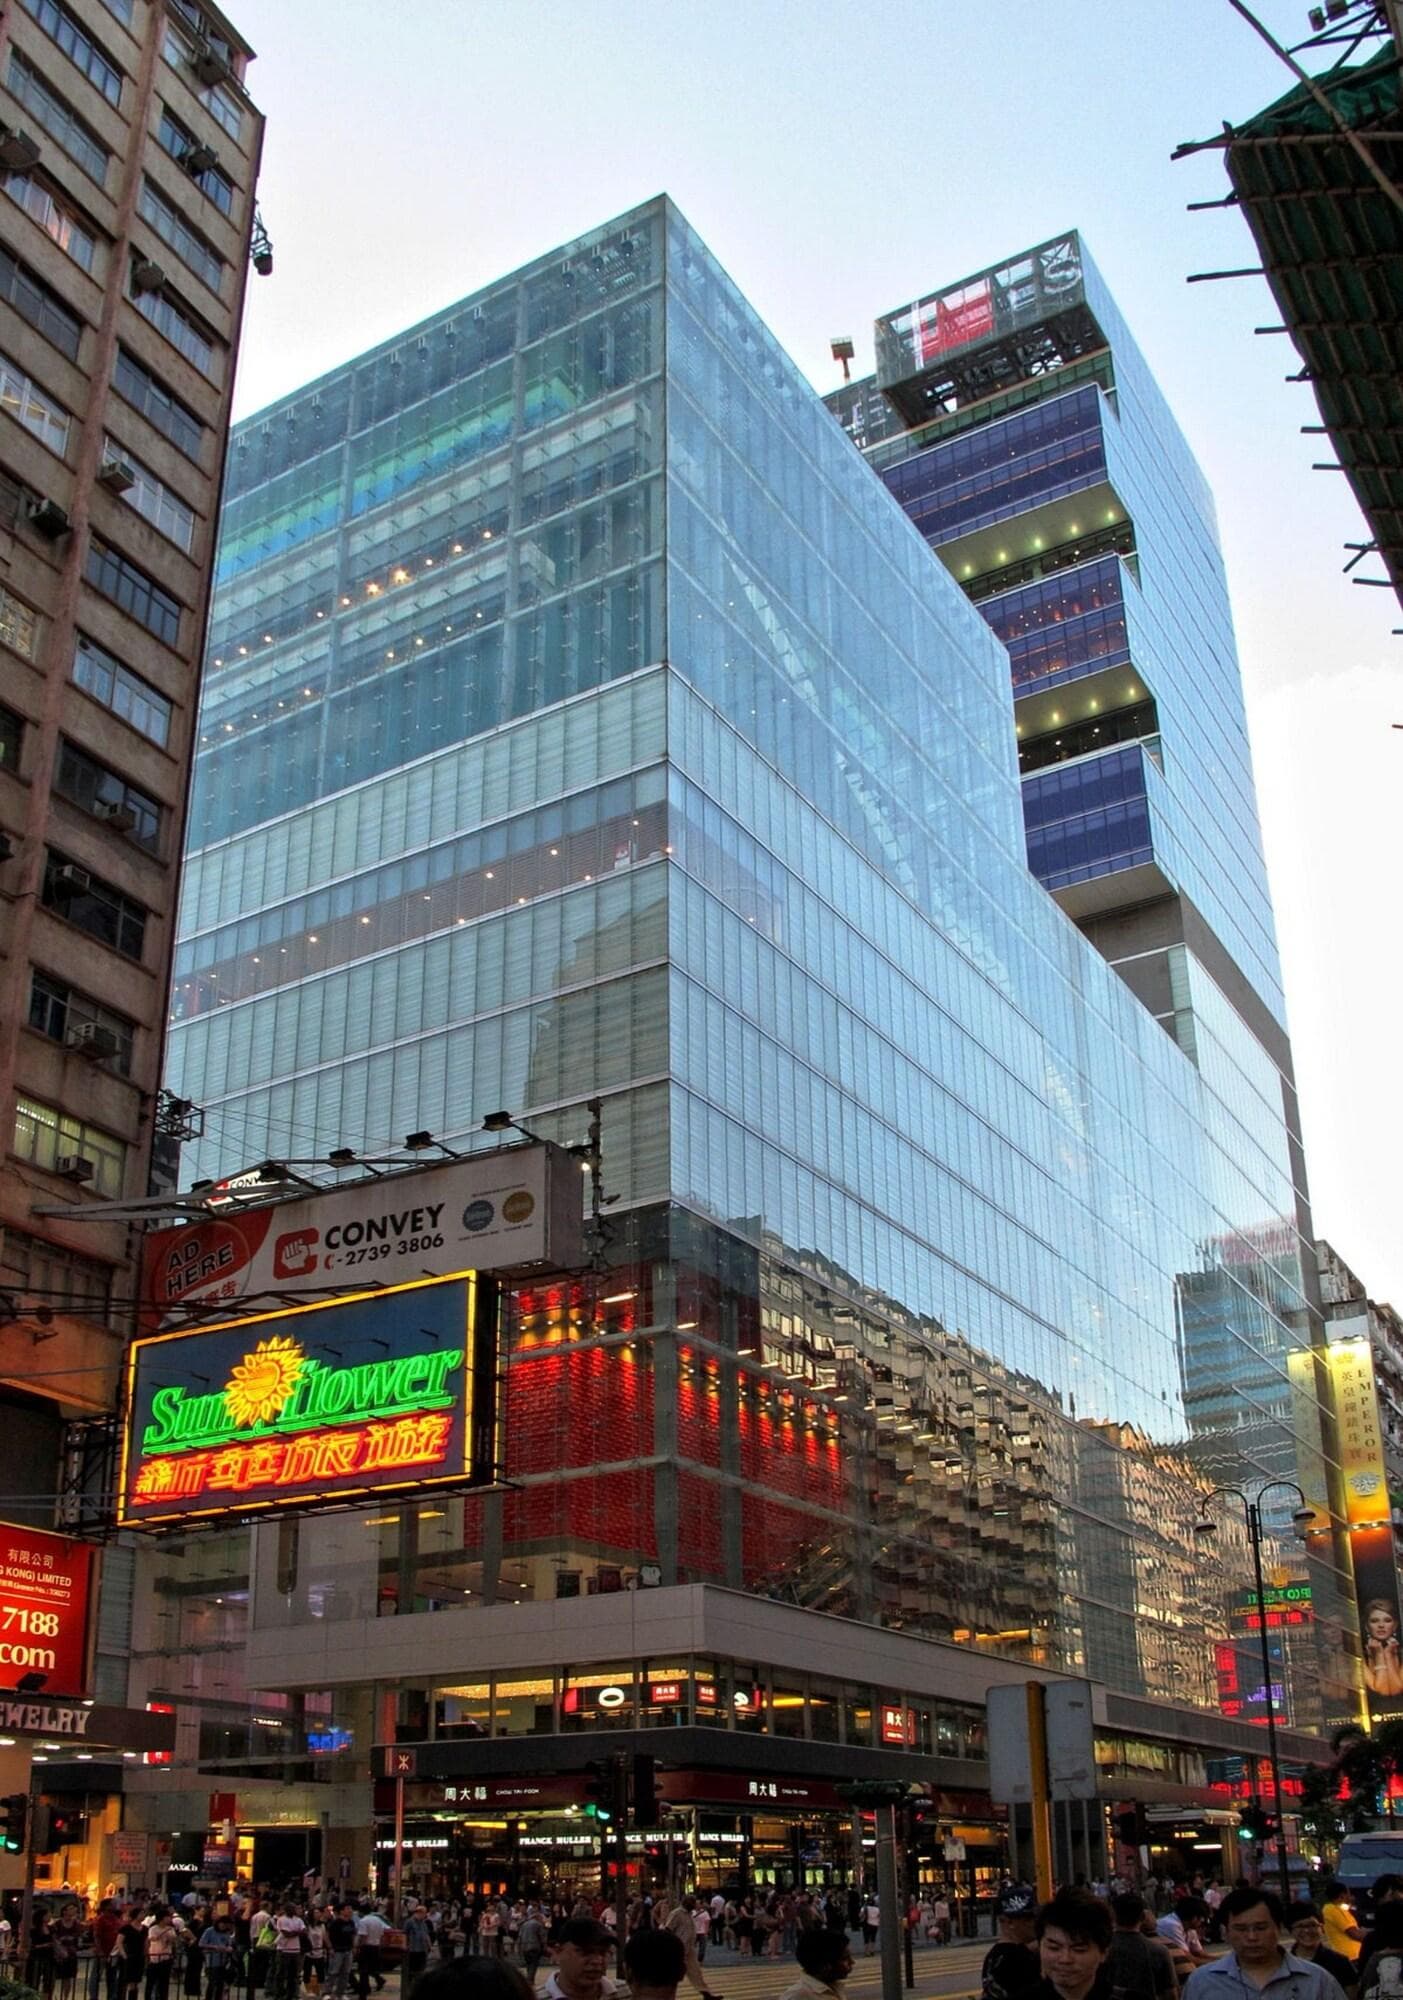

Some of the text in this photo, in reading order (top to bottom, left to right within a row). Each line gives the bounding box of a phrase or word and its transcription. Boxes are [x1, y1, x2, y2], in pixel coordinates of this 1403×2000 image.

[325, 1203, 446, 1250] CONVEY
[397, 1233, 445, 1255] 3806
[168, 1241, 199, 1274] AD
[168, 1243, 233, 1297] HERE
[144, 1349, 465, 1445] Sunflower
[1357, 1368, 1377, 1463] EMPEROR
[8, 1549, 54, 1569] 有限公司
[6, 1567, 36, 1582] KONG)
[37, 1572, 73, 1587] LIMITED
[2, 1606, 59, 1638] 7188
[444, 1786, 487, 1801] 周大福
[383, 1840, 414, 1848] FRACK
[520, 1836, 592, 1845] FRANCK MULLER
[606, 1835, 642, 1843] FRNCK
